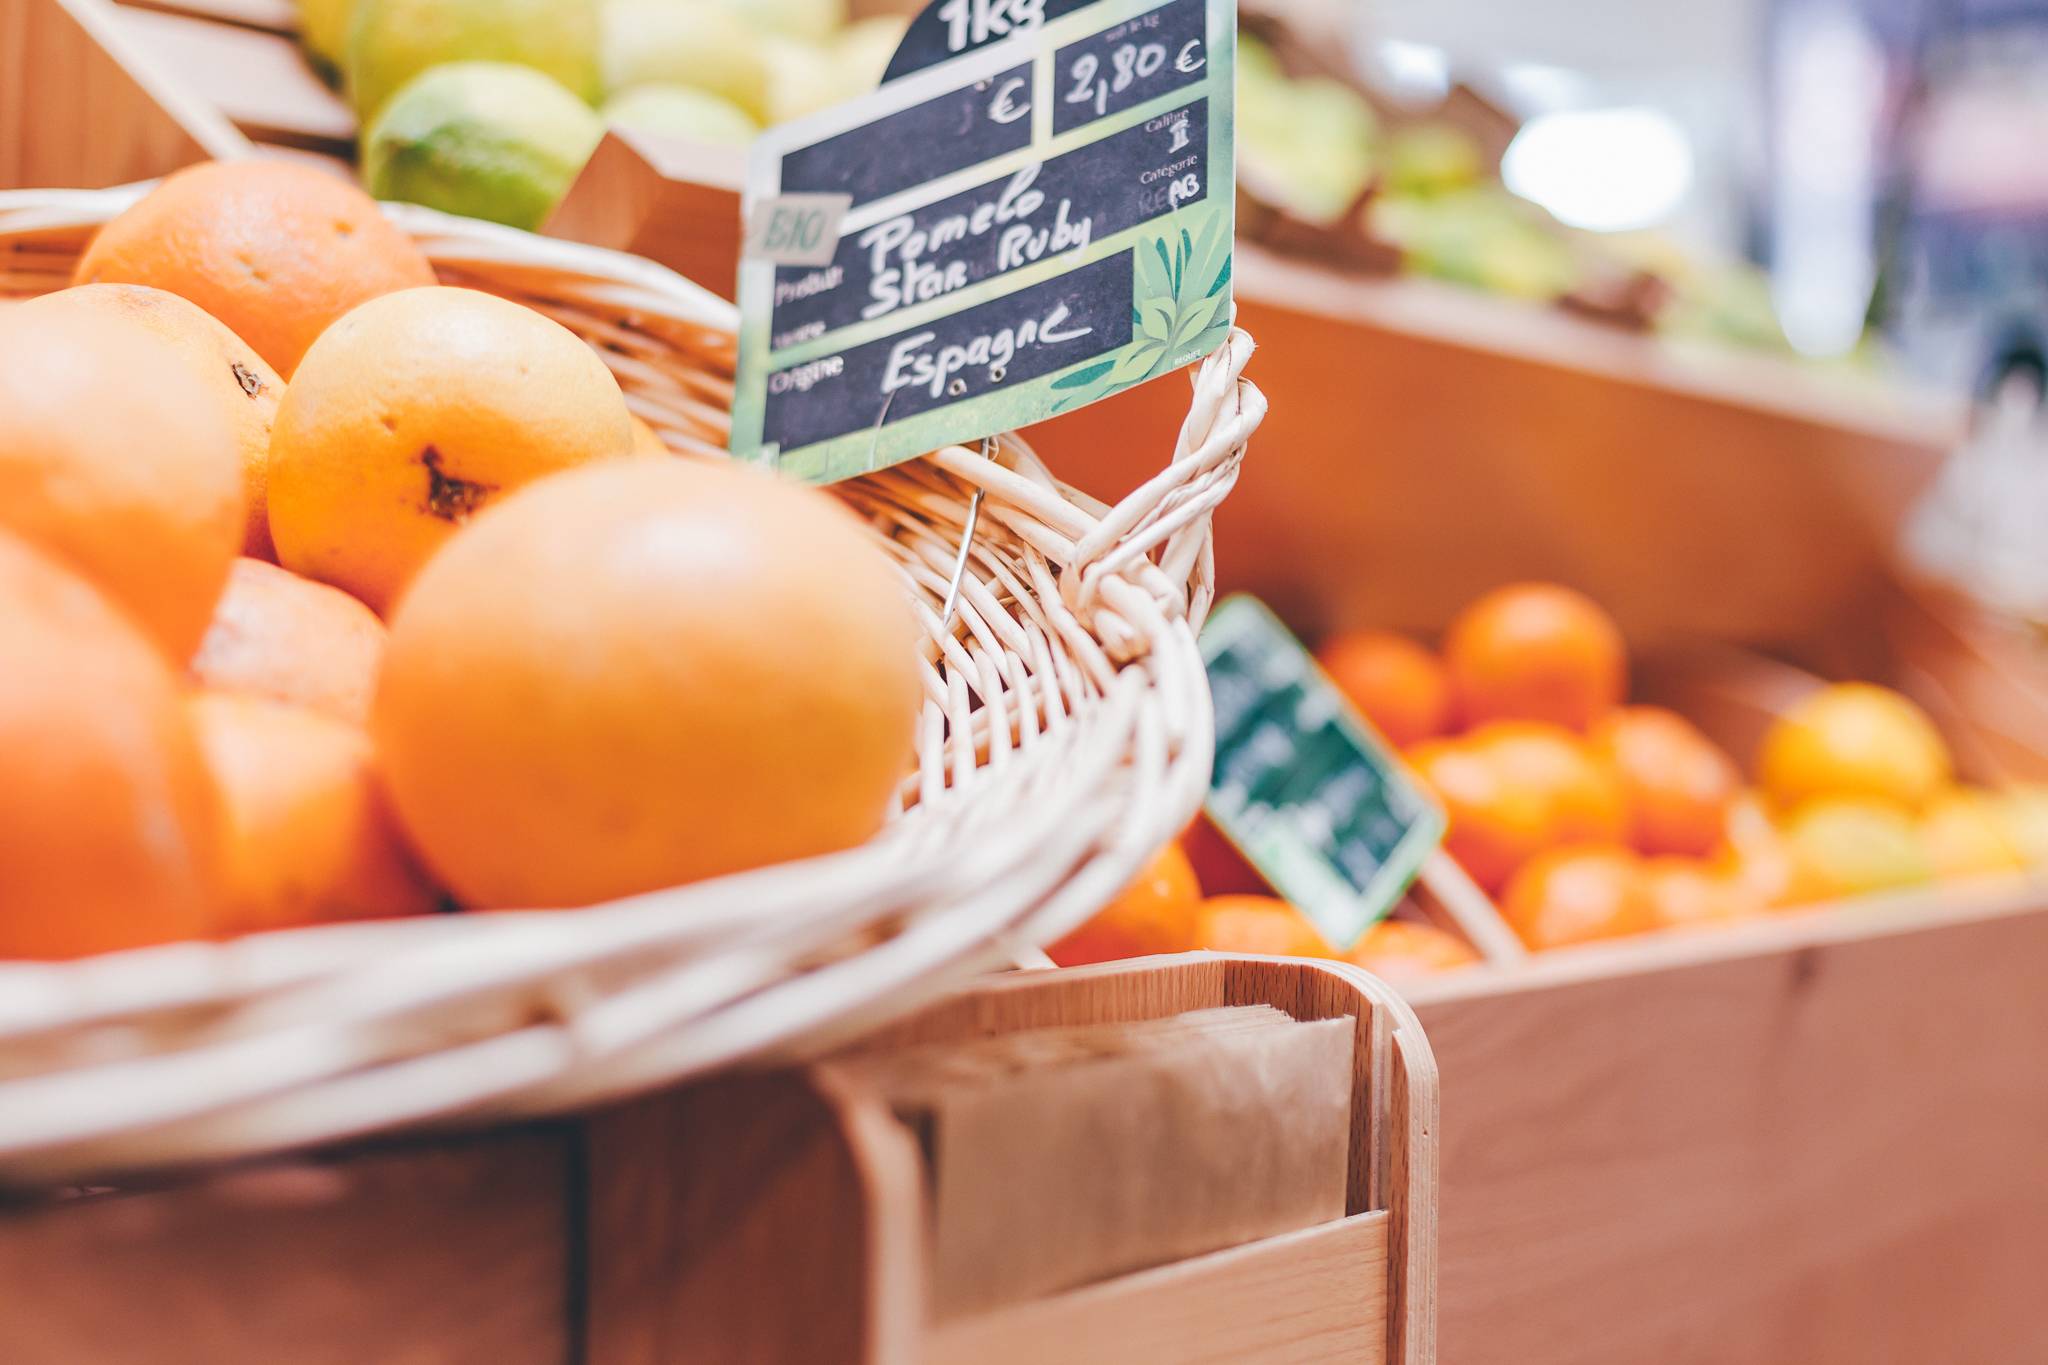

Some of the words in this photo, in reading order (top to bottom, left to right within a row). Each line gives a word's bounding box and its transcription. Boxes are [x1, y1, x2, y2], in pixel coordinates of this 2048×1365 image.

[988, 76, 1032, 124] €
[1065, 42, 1168, 116] 2,80
[1174, 38, 1207, 73] €
[764, 208, 825, 250] BIO
[858, 161, 1046, 274] Pomelo
[997, 198, 1093, 272] Ruby
[880, 301, 1093, 399] Espagne
